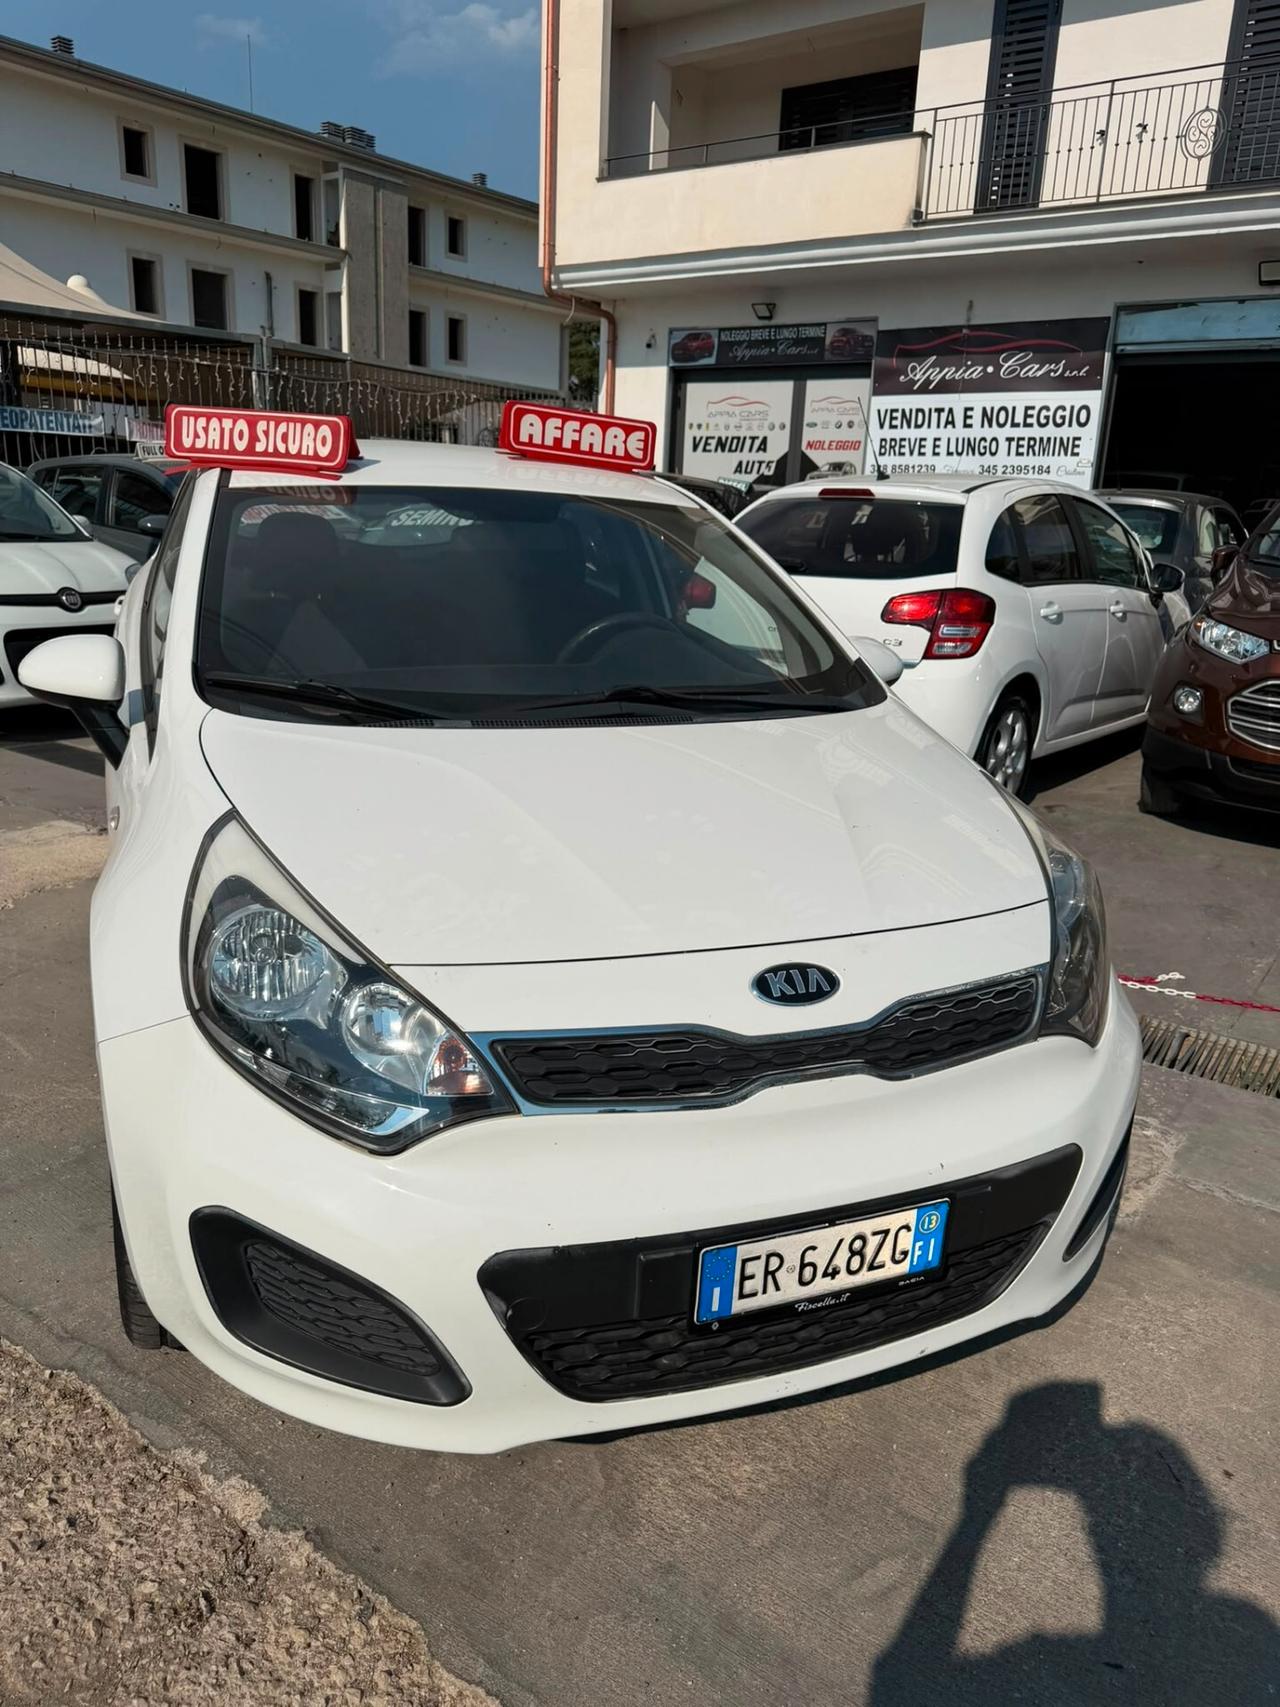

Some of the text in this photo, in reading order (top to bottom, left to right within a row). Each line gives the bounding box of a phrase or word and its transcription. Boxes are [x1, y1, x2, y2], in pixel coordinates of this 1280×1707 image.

[720, 326, 826, 341] NOLEGGIO BREVE E LUNGO TERMINE
[899, 355, 985, 390] Appia
[999, 351, 1066, 379] Cars
[877, 404, 1091, 430] VENDITA E NOLEGGIO
[181, 416, 250, 452] USATO
[255, 420, 333, 458] SICURO
[519, 413, 646, 460] AFFARE
[692, 436, 769, 453] VENDITA
[805, 440, 862, 451] NOLEGGIO
[878, 436, 1082, 457] BREVE E LUNGO TERMINE
[891, 464, 936, 474] 8581239
[978, 465, 998, 475] 345
[1001, 465, 1051, 475] 2395184
[764, 968, 831, 997] KIA
[924, 1215, 938, 1230] 13
[738, 1222, 935, 1300] ER 648ZG FI
